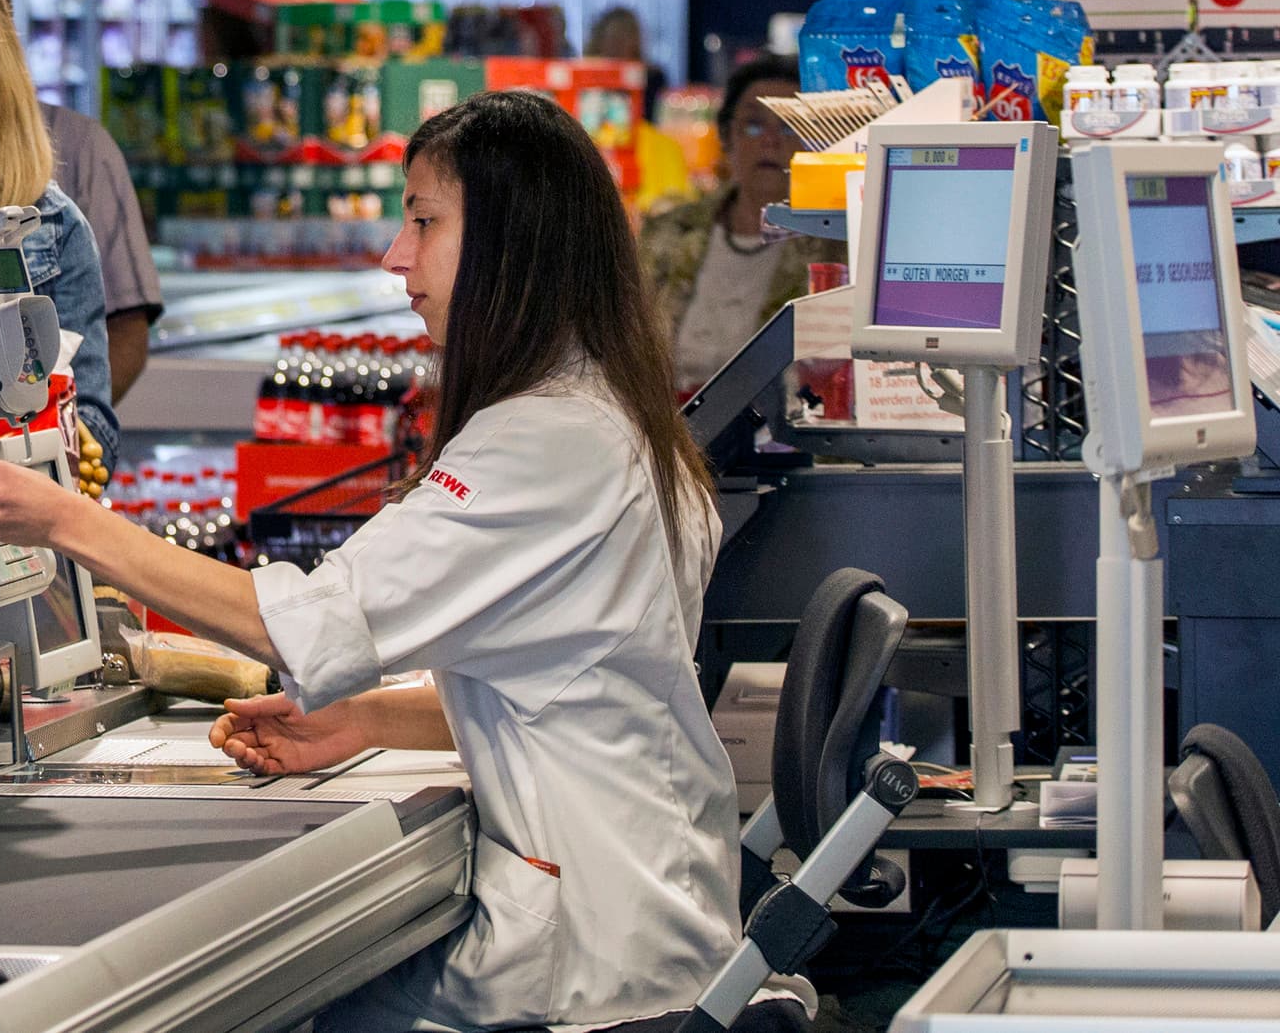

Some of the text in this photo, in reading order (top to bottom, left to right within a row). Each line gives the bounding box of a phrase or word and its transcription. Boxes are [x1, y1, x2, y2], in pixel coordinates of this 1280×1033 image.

[903, 267, 931, 281] GUTEN
[935, 268, 970, 282] MORGEN
[870, 377, 882, 388] 18
[869, 394, 912, 406] werden
[428, 469, 471, 501] REWE
